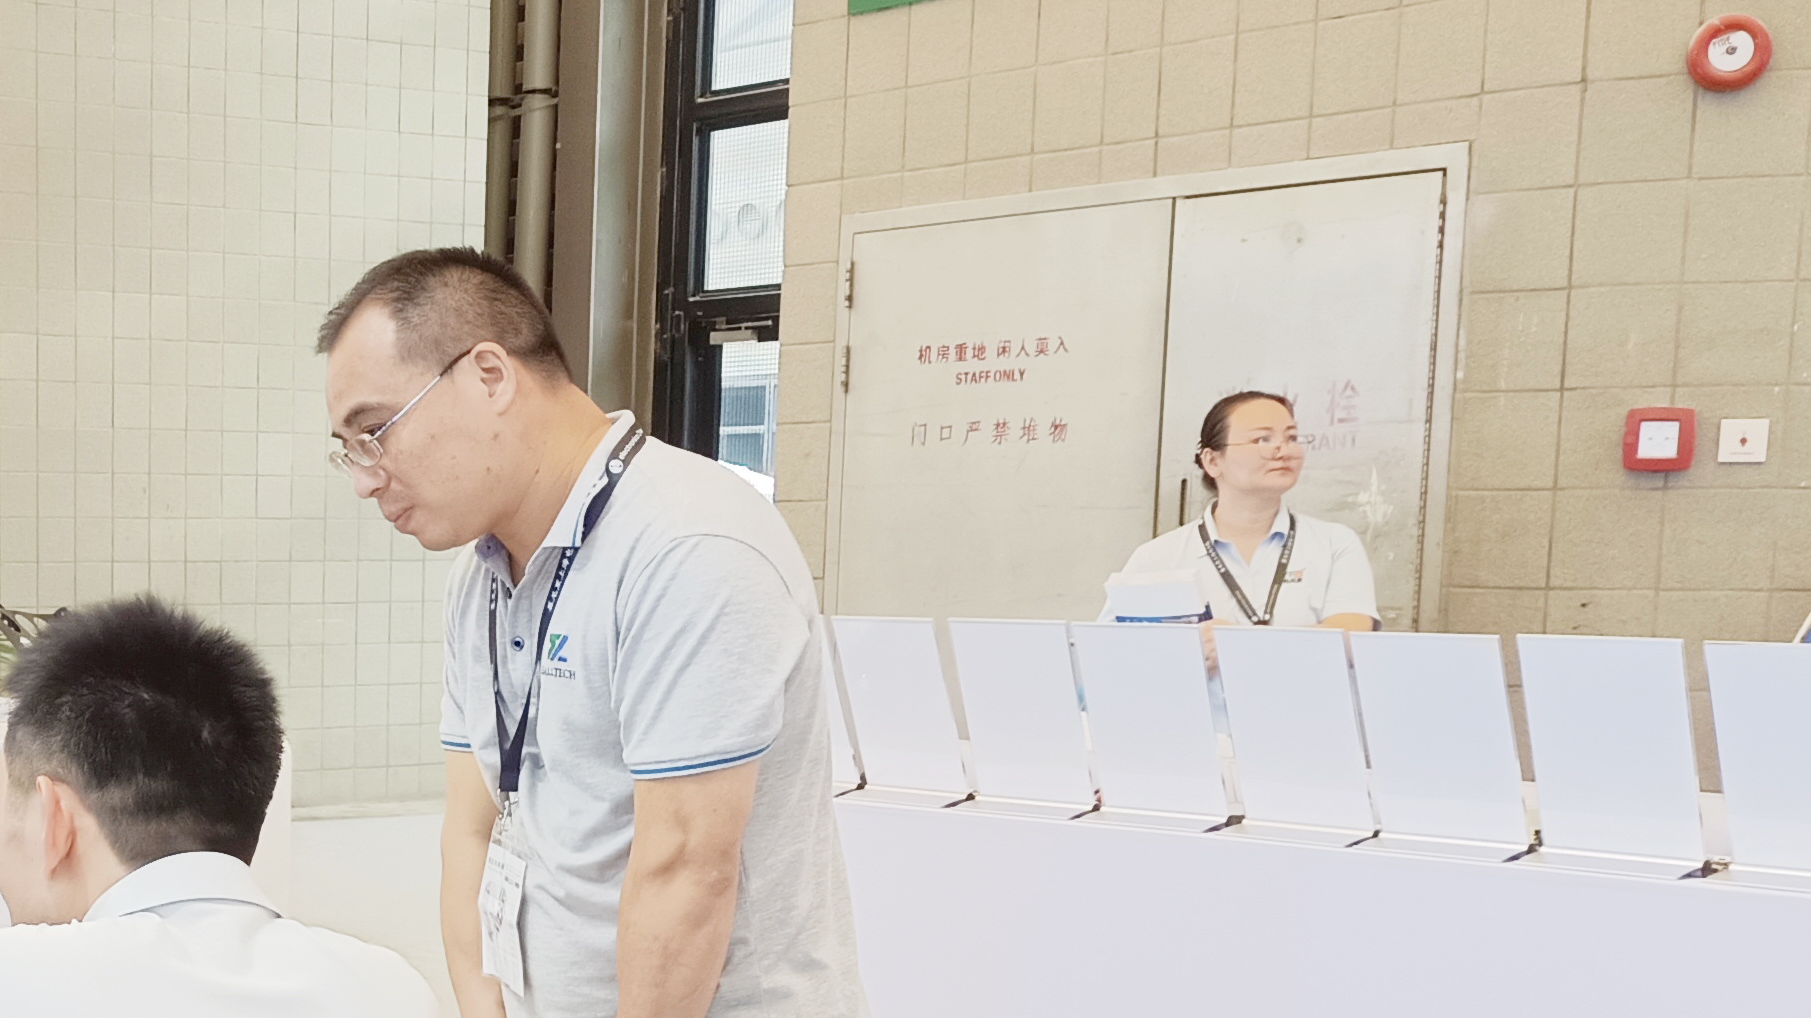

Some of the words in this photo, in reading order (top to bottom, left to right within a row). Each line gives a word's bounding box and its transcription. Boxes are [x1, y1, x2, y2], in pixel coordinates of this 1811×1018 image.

[917, 342, 987, 366] 机房重地
[910, 416, 1069, 447] 门口严禁堆物
